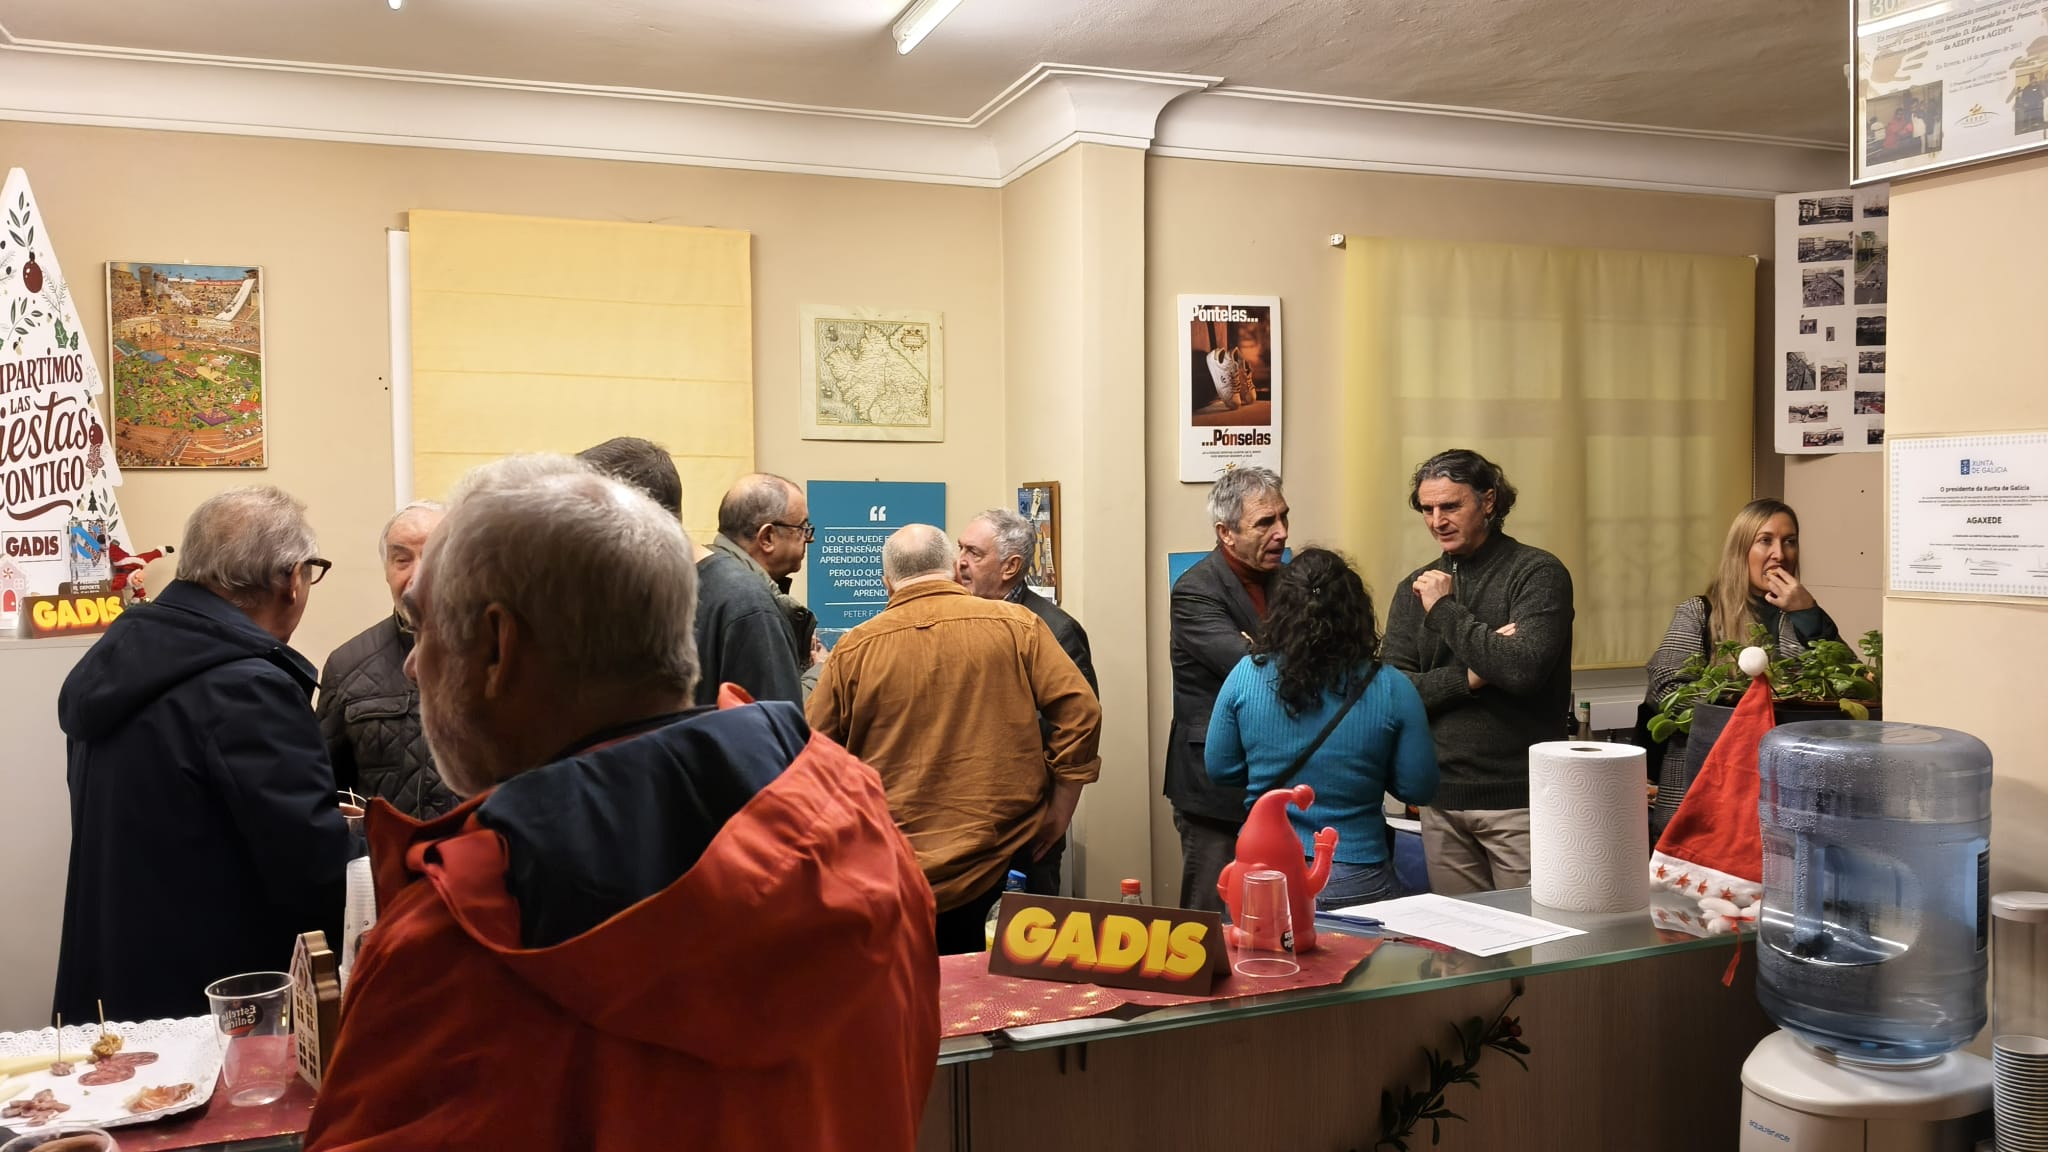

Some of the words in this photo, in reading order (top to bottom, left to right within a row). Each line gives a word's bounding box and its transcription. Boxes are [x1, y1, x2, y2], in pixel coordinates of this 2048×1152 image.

[10, 396, 31, 415] LAS
[1201, 429, 1272, 447] ...Pónselas
[1972, 459, 1994, 467] XUNTA
[1981, 466, 2008, 474] GALICIA
[1945, 485, 1975, 493] presidente
[1966, 516, 2002, 525] AGAXEDE
[824, 535, 836, 543] LO
[837, 535, 855, 544] QUE
[856, 535, 883, 543] PUEDE
[5, 536, 58, 557] GADIS
[822, 545, 844, 554] DEBE
[819, 555, 868, 564] APRENDIDO
[869, 555, 881, 564] DE
[829, 569, 851, 577] PERO
[852, 569, 864, 577] LO
[864, 569, 883, 578] QUE
[833, 579, 884, 588] APRENDIDO,
[32, 596, 124, 630] GADIS
[843, 610, 867, 618] PETER
[1003, 907, 1209, 981] GADIS
